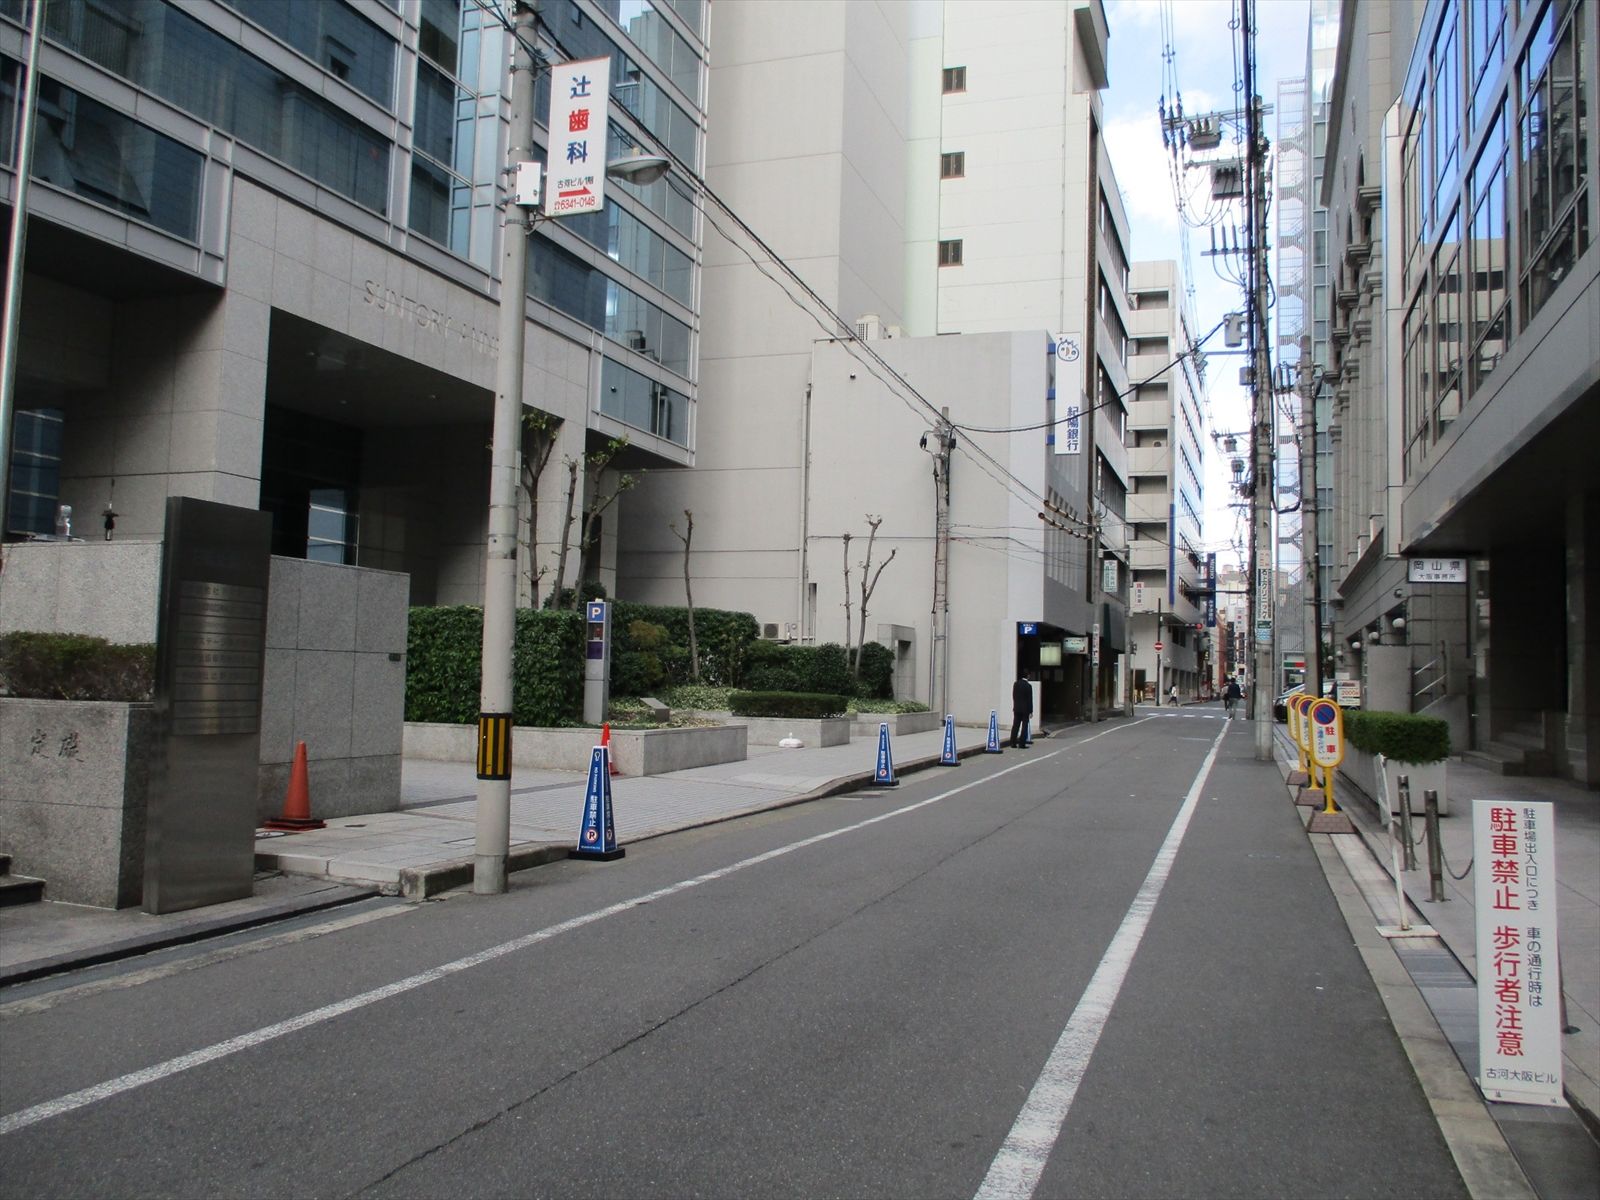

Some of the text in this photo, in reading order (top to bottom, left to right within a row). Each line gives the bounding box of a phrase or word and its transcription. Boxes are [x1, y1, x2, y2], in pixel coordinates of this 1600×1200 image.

[567, 75, 591, 165] 辻歯科
[364, 279, 453, 339] SUNTORY
[1066, 406, 1079, 452] 紀陽銀行
[1413, 560, 1461, 571] 岡山県
[592, 607, 601, 618] P
[1024, 626, 1033, 634] P
[1523, 807, 1543, 1008] 駐車場出入口につき 車の通行時は
[1490, 807, 1524, 1057] 駐車禁止 歩行者注意
[1485, 1067, 1558, 1085] 古河大阪ビル
